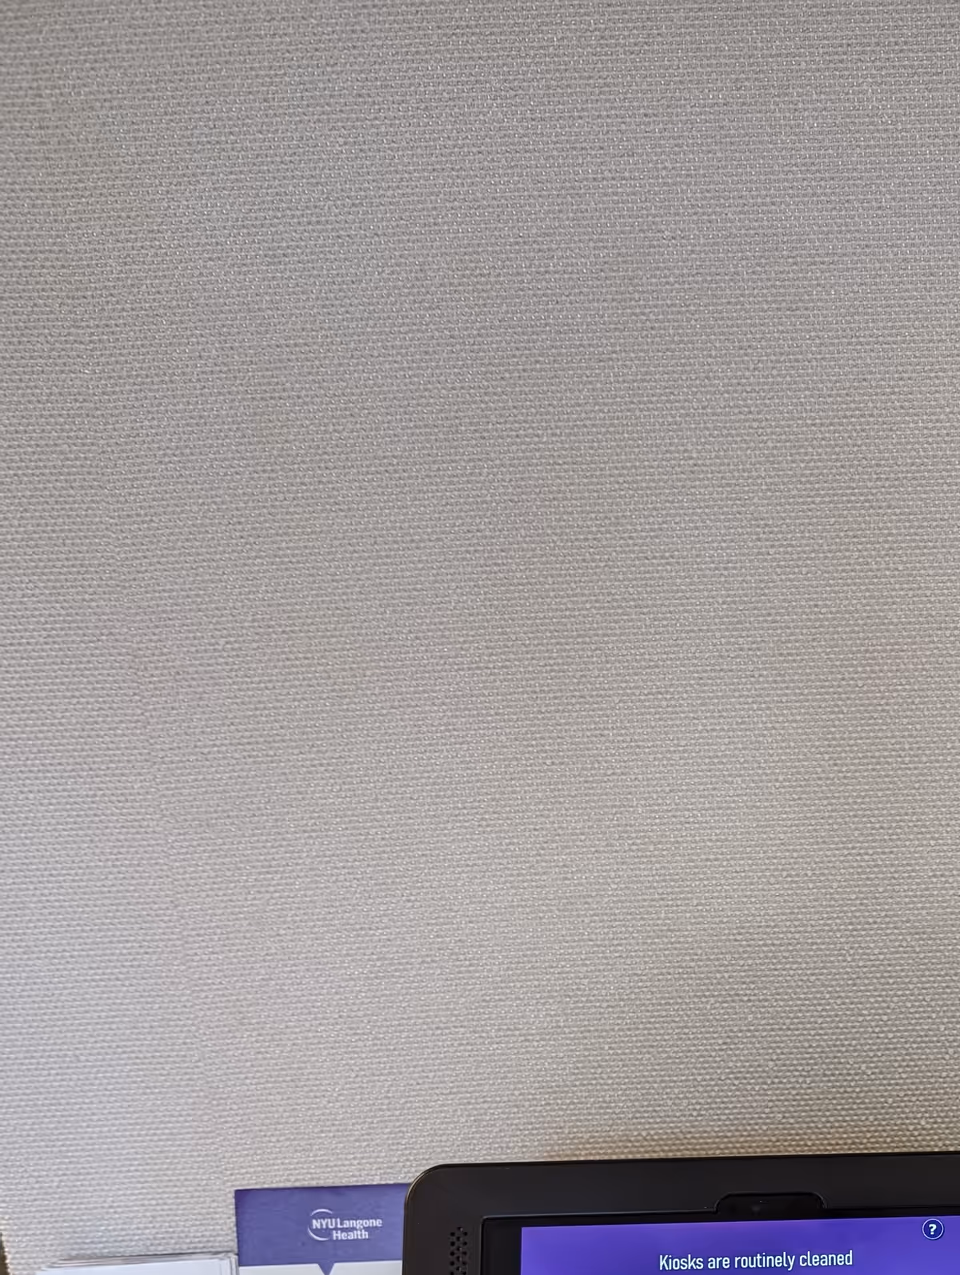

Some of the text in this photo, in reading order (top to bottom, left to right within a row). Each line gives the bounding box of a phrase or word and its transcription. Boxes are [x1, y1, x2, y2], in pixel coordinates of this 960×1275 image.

[312, 1217, 383, 1229] NYU Langone
[333, 1230, 369, 1240] Health
[659, 1249, 853, 1273] Kiosks are routinely cleaned
